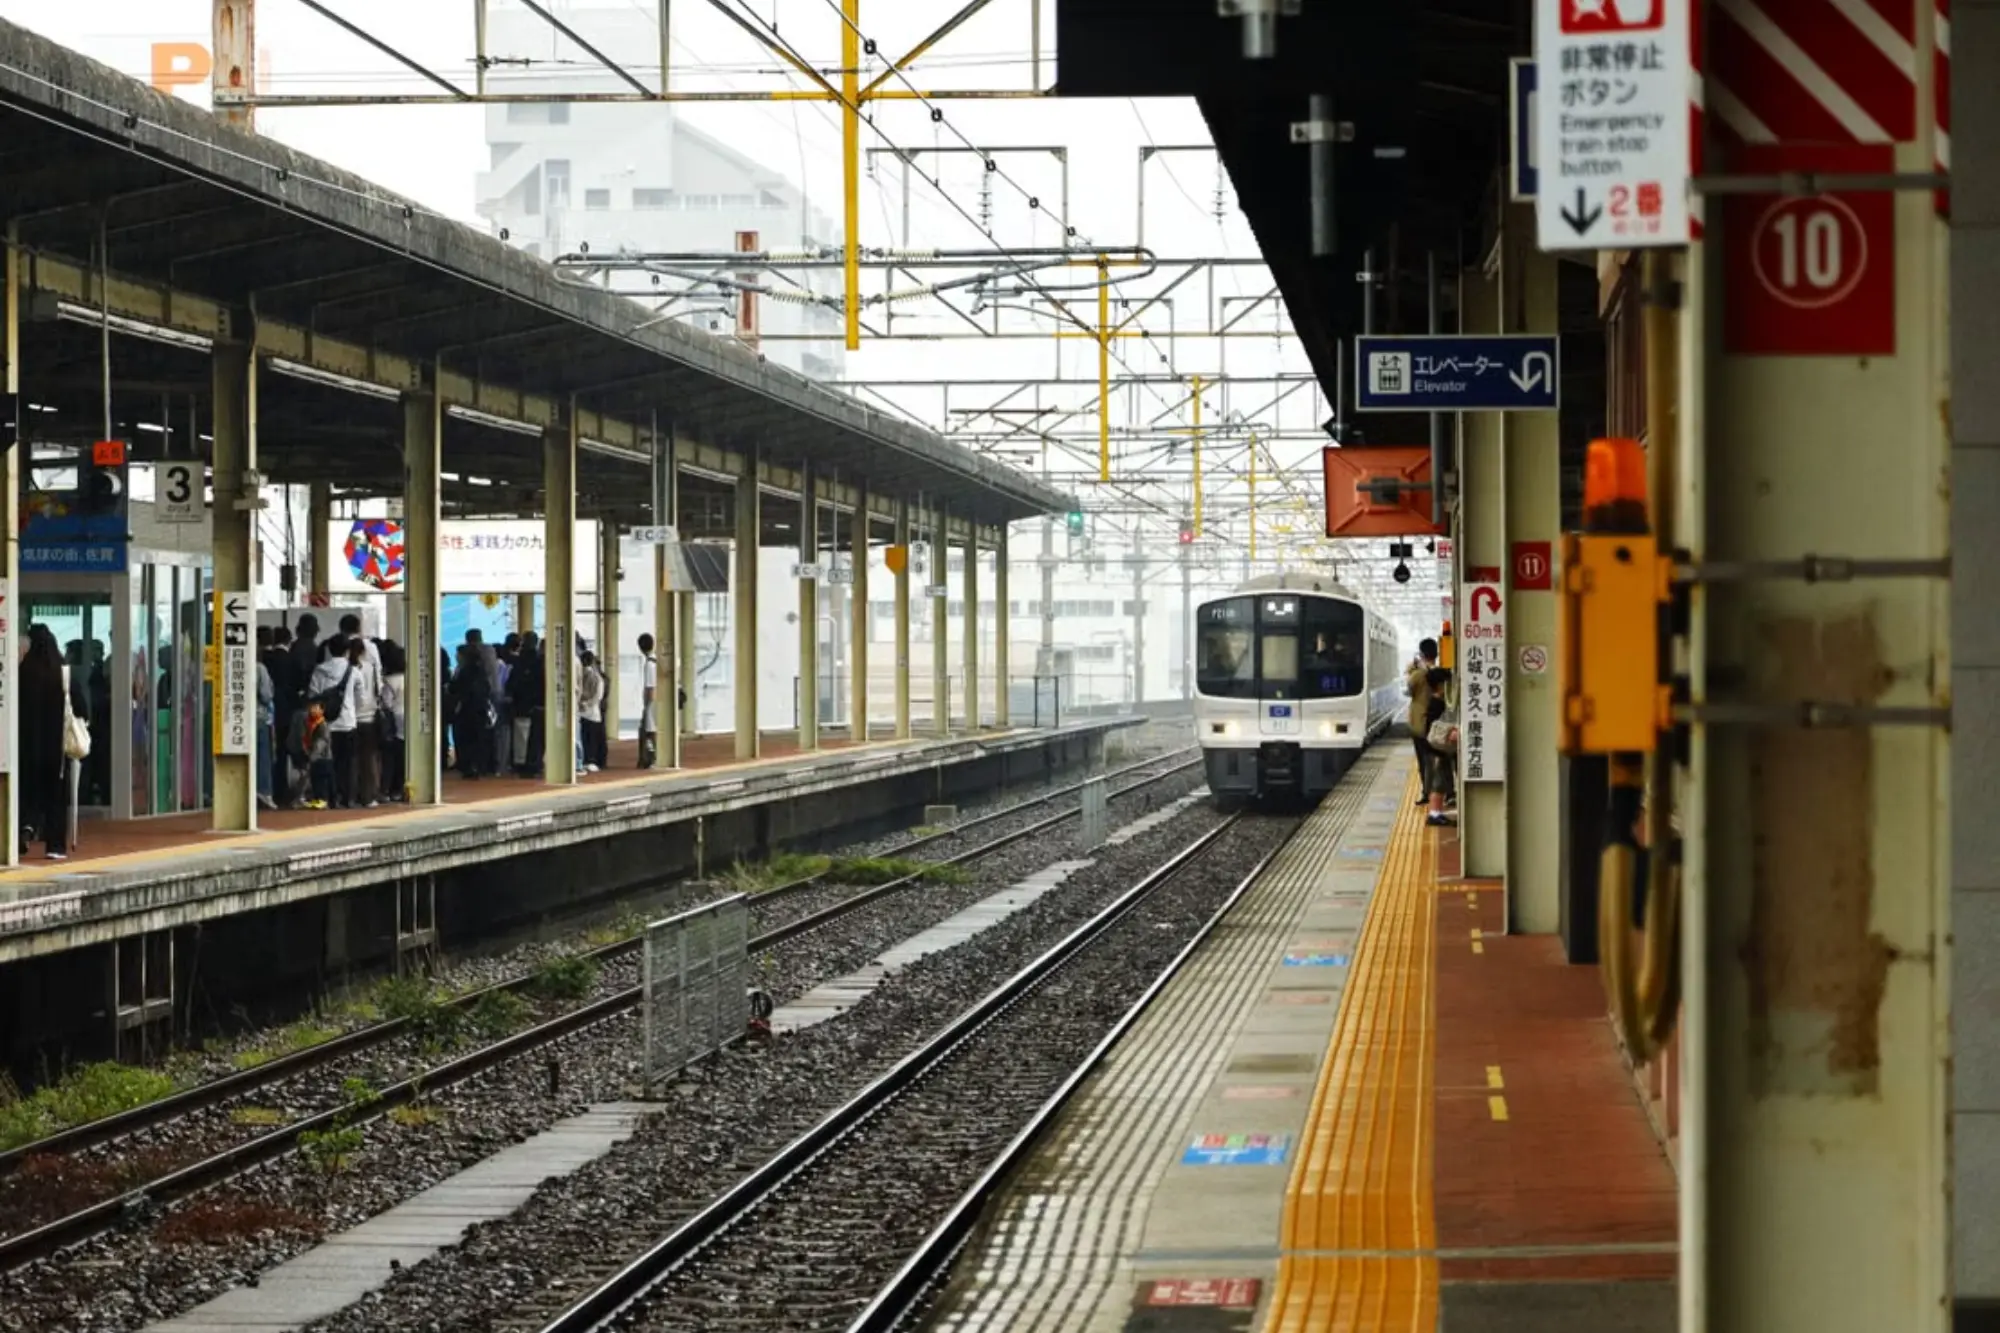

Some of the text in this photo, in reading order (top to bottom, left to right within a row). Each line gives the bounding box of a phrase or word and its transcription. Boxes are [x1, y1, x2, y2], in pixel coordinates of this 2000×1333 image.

[1560, 42, 1664, 73] 非常停止
[1560, 78, 1638, 106] ボタン
[1560, 115, 1664, 132] Emergency
[1560, 135, 1648, 153] train stop
[1560, 159, 1623, 176] button
[1774, 211, 1841, 289] 10
[1413, 355, 1504, 376] エレベーター
[1414, 380, 1467, 392] Elevator
[166, 465, 191, 502] 3
[1523, 557, 1539, 576] 11
[1464, 624, 1503, 639] 60m先
[1467, 645, 1483, 779] 小城・多久・唐津方面
